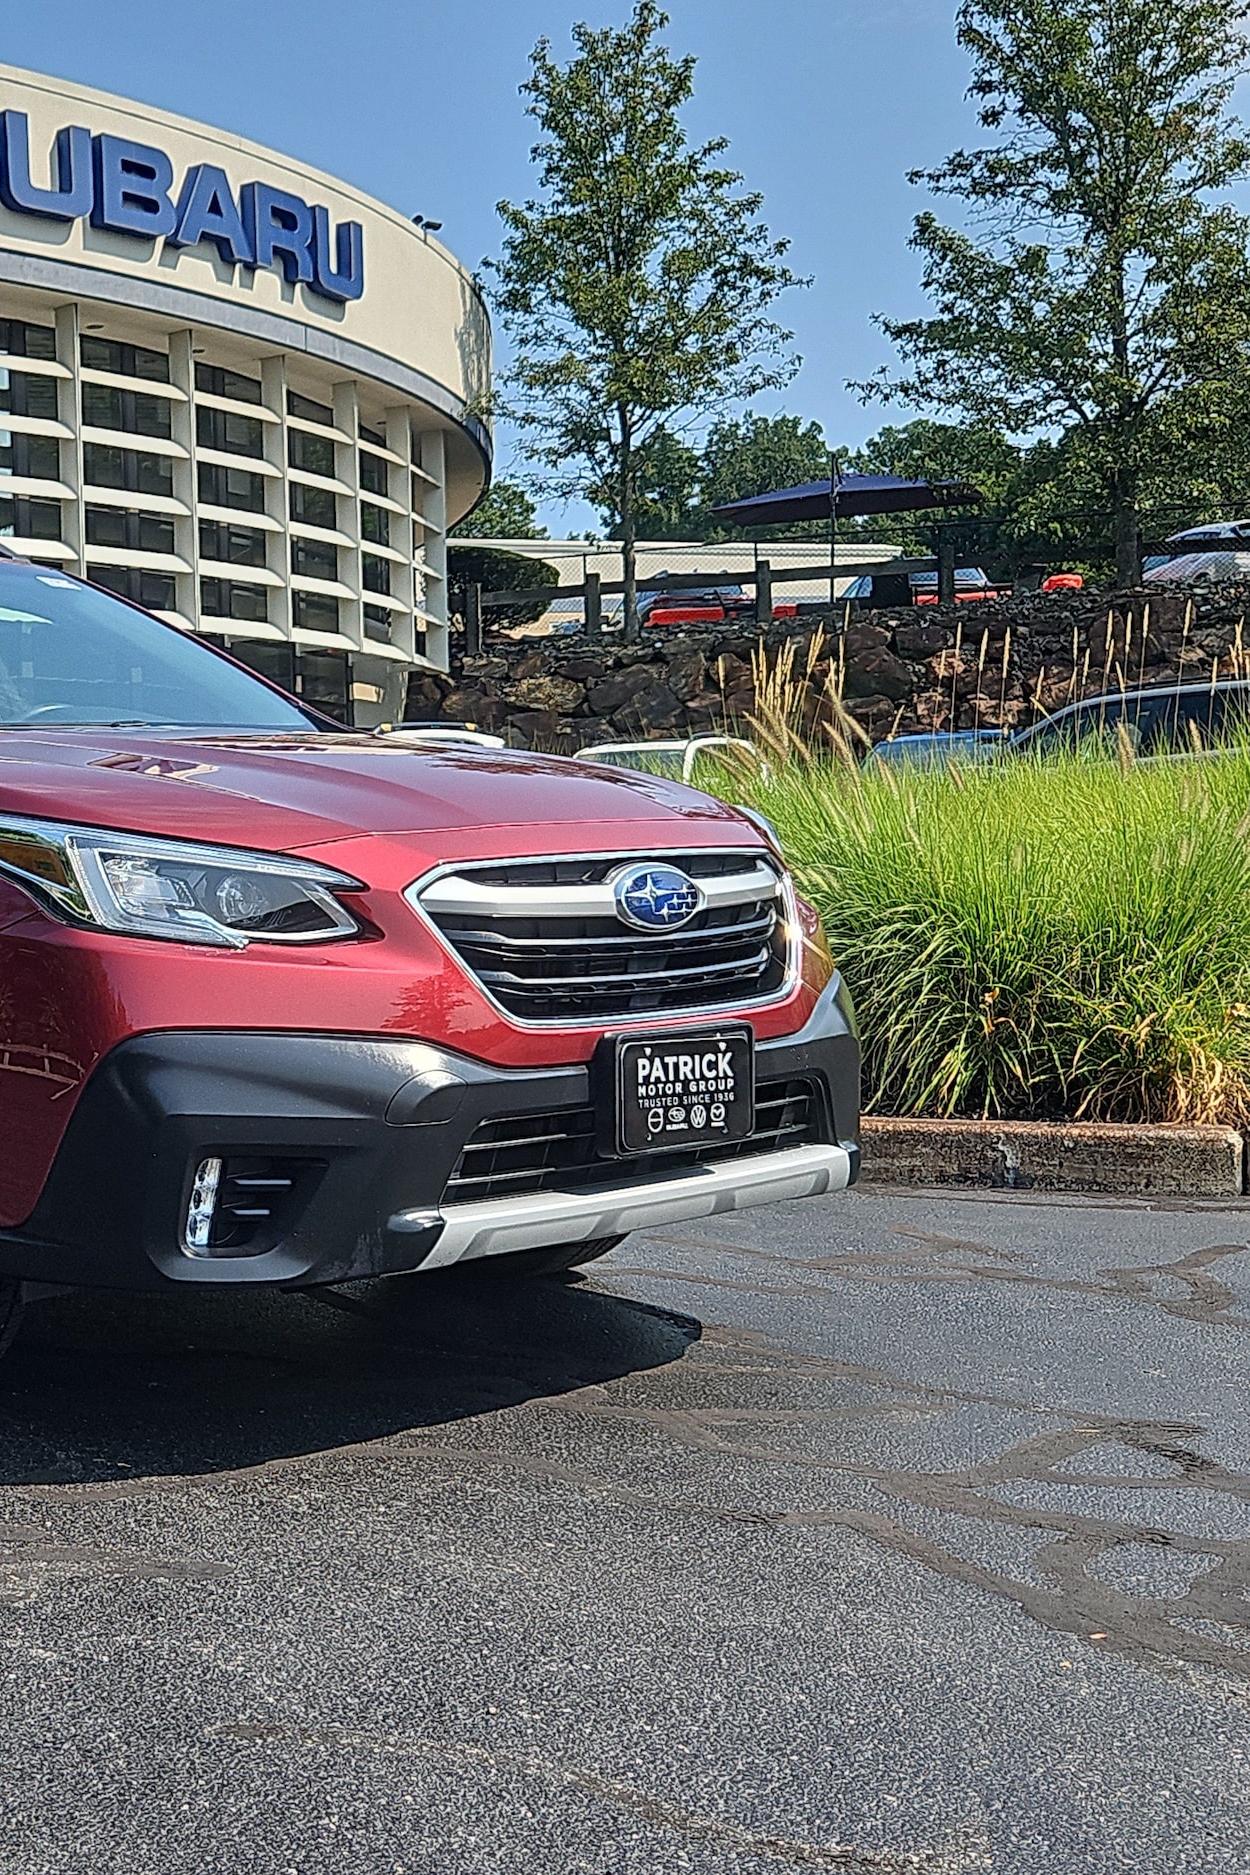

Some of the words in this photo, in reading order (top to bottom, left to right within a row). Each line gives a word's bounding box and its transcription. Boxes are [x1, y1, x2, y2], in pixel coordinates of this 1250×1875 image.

[637, 1052, 734, 1083] PATRICK
[638, 1082, 682, 1097] MOTOR
[689, 1078, 734, 1092] GROUP
[638, 1097, 678, 1108] TRUSTED
[683, 1094, 710, 1105] SINCE
[714, 1092, 734, 1102] 1936
